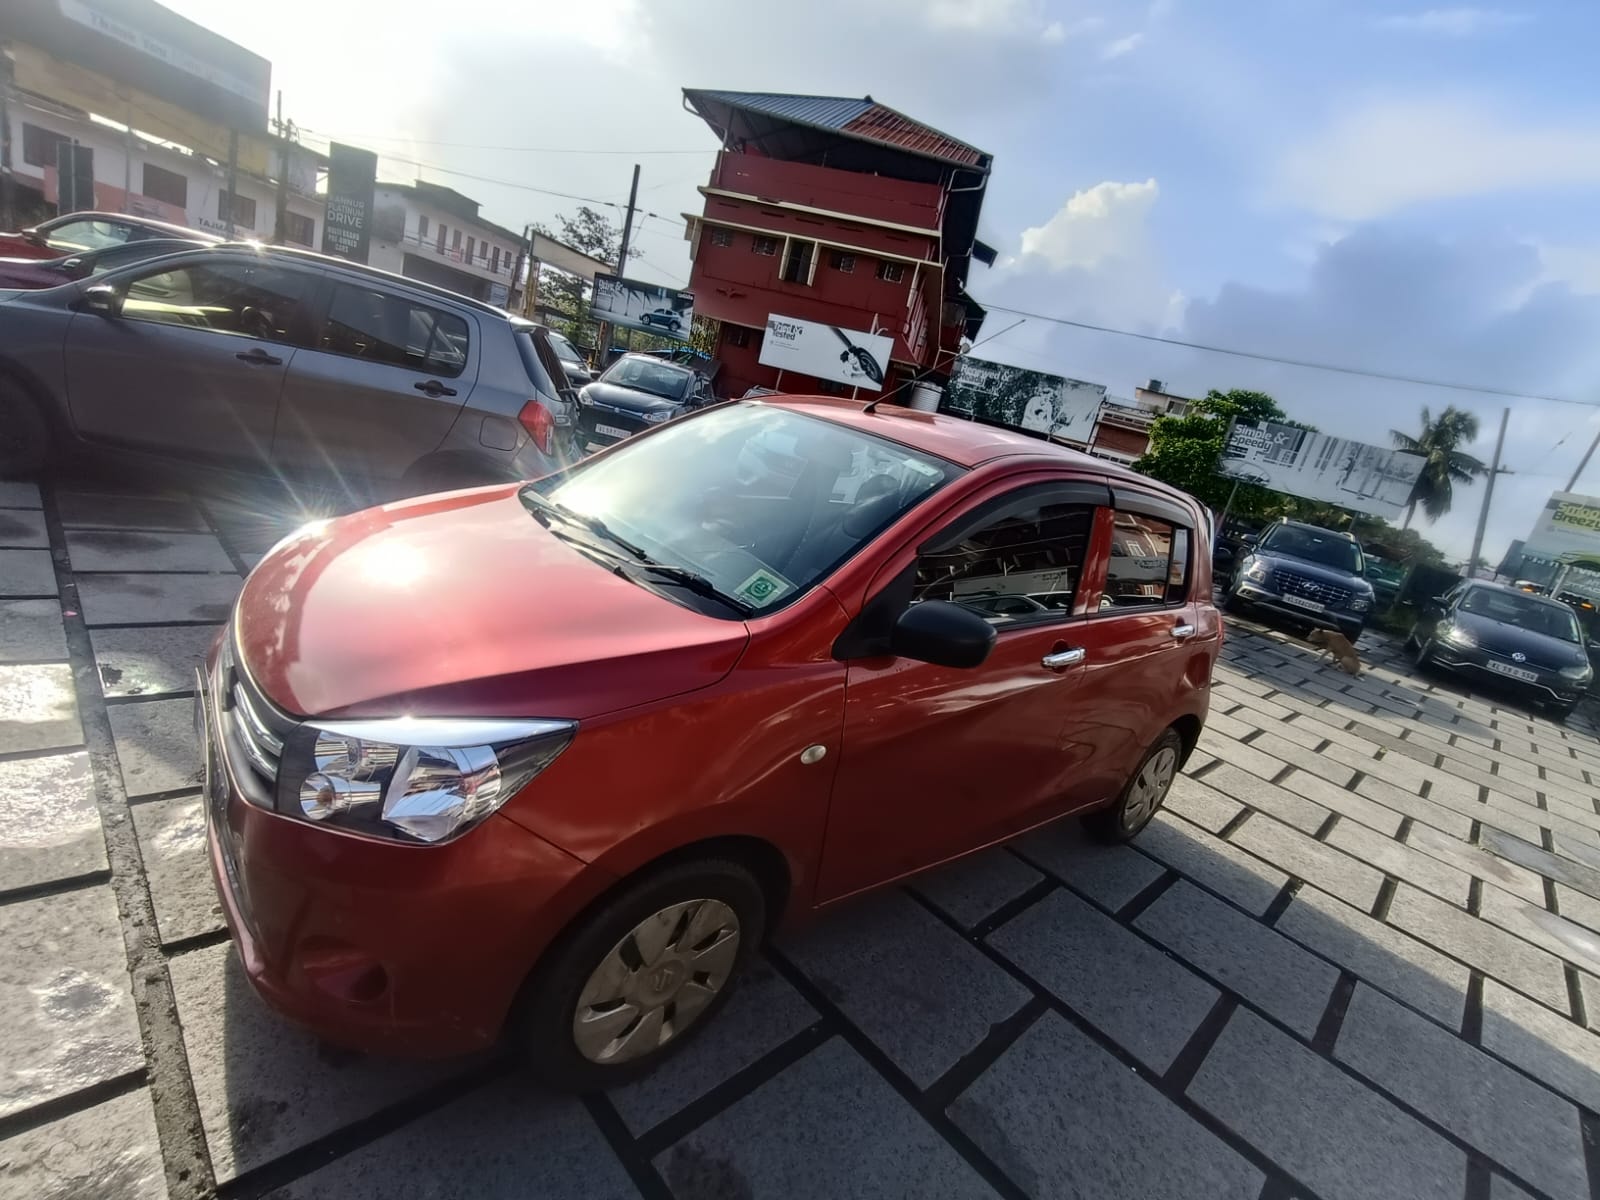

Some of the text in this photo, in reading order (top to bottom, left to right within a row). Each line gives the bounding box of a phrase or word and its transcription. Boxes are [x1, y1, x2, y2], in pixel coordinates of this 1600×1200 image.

[328, 210, 363, 229] DRIVE
[1235, 424, 1290, 445] Simple &
[1230, 436, 1274, 454] Speedy
[1552, 510, 1600, 532] Breezy
